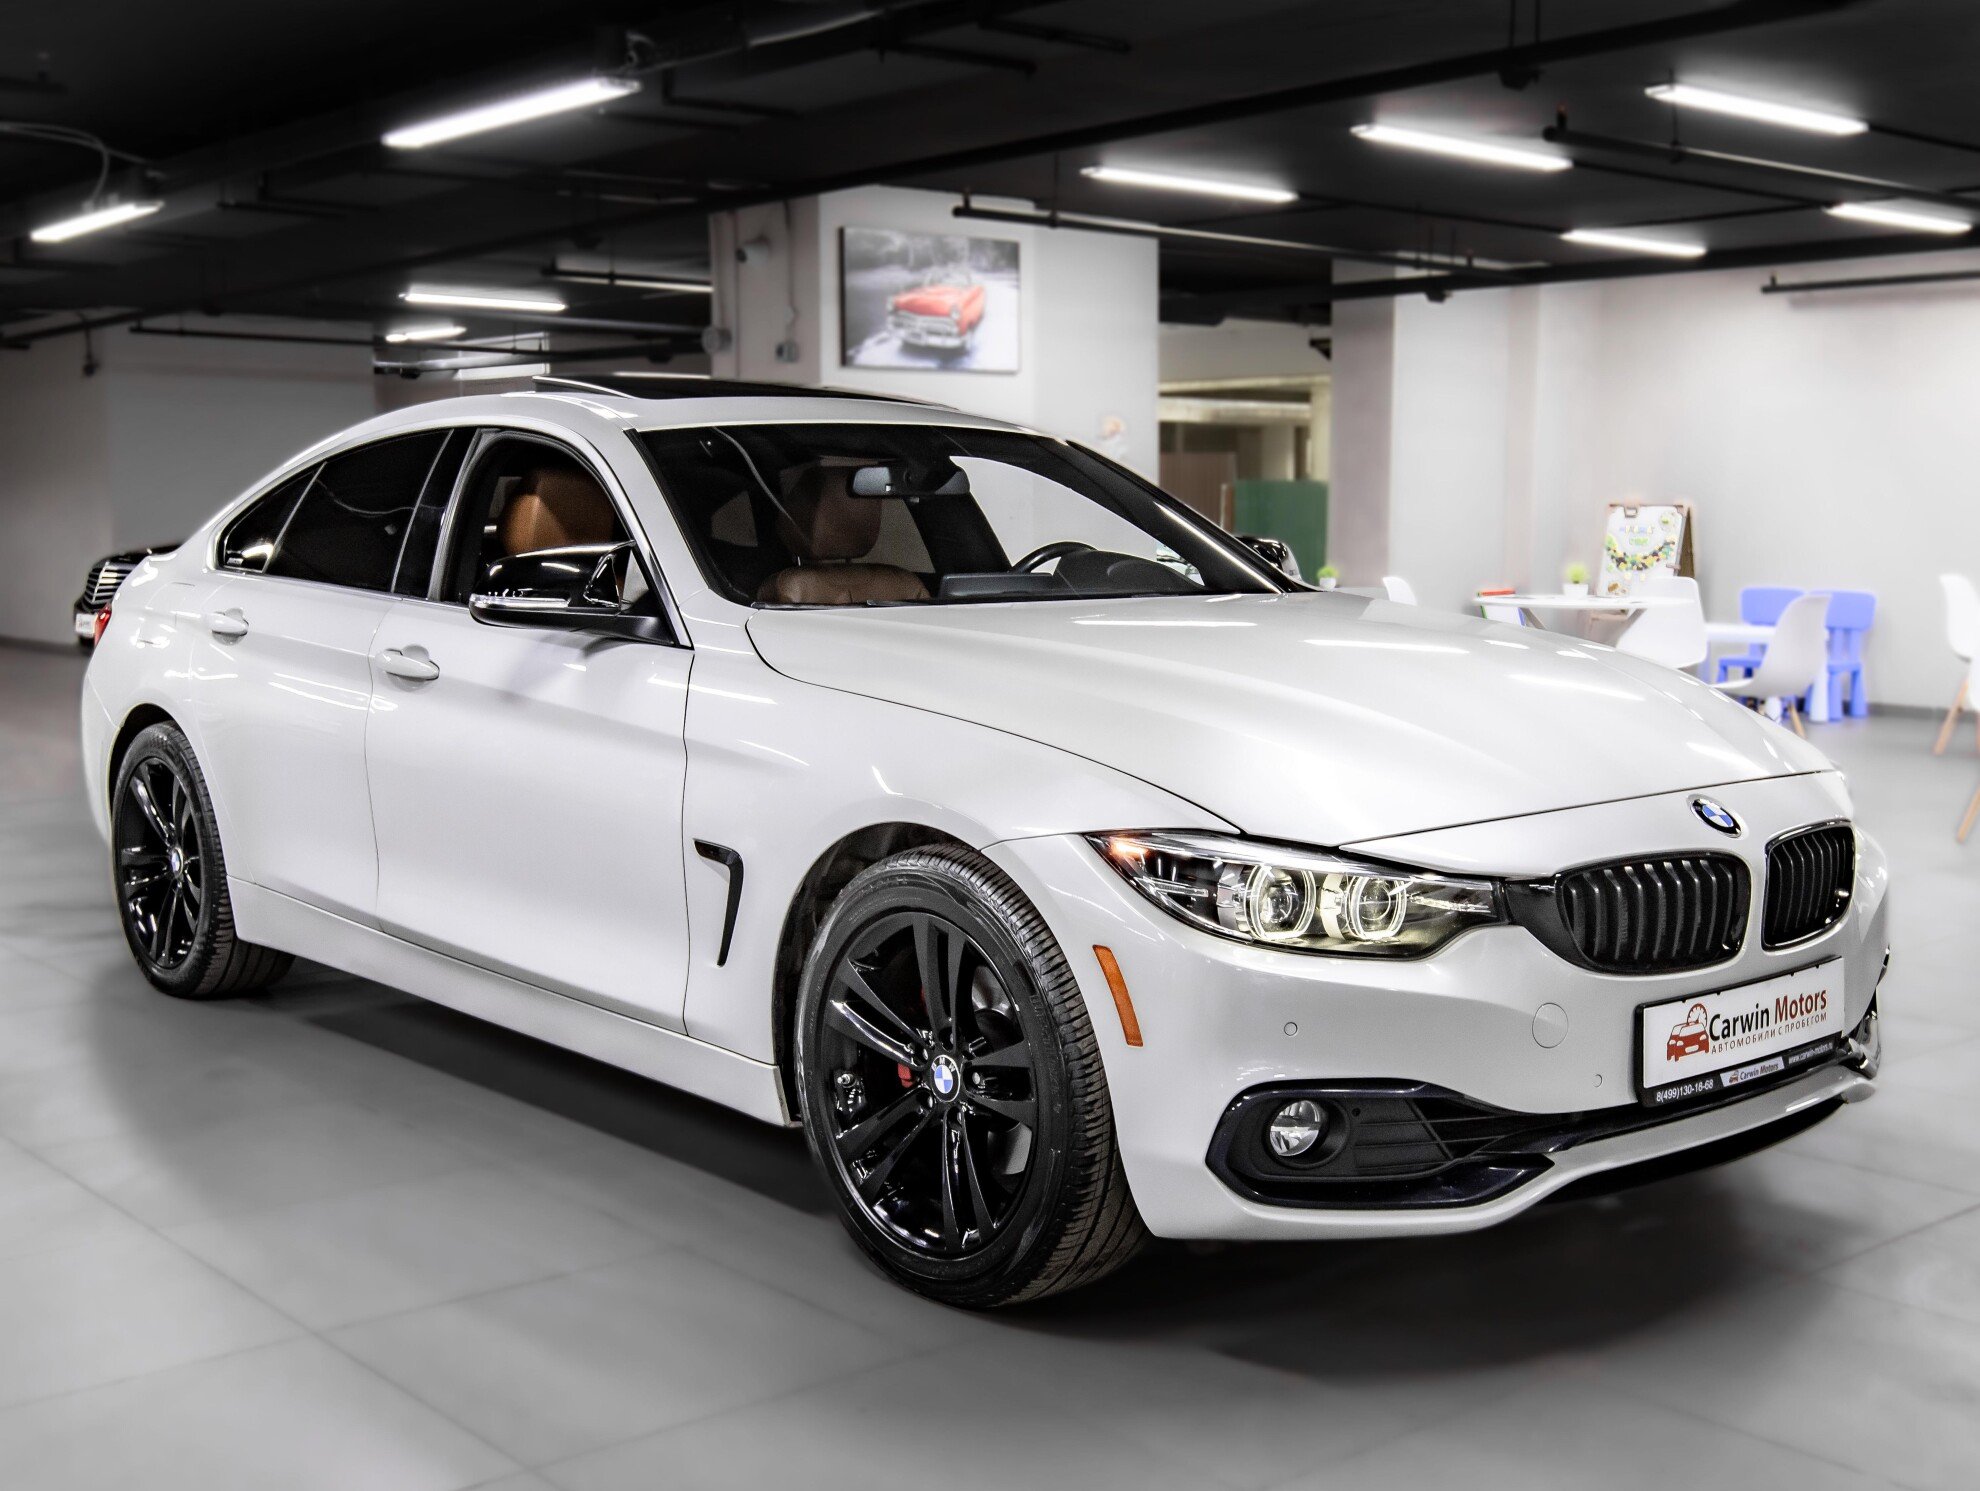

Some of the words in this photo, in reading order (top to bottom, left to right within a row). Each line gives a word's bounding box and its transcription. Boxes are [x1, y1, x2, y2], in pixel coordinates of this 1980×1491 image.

[1709, 1002, 1770, 1042] Carwin
[1774, 989, 1827, 1025] Motors
[1711, 1029, 1776, 1054] АВТОМОБИЛИ
[1778, 1026, 1783, 1036] С
[1785, 1012, 1827, 1033] ПРОБЕГОМ
[1739, 1067, 1760, 1080] Carwin
[1760, 1063, 1779, 1075] Motors
[1656, 1078, 1714, 1103] 8(499)130-18-68
